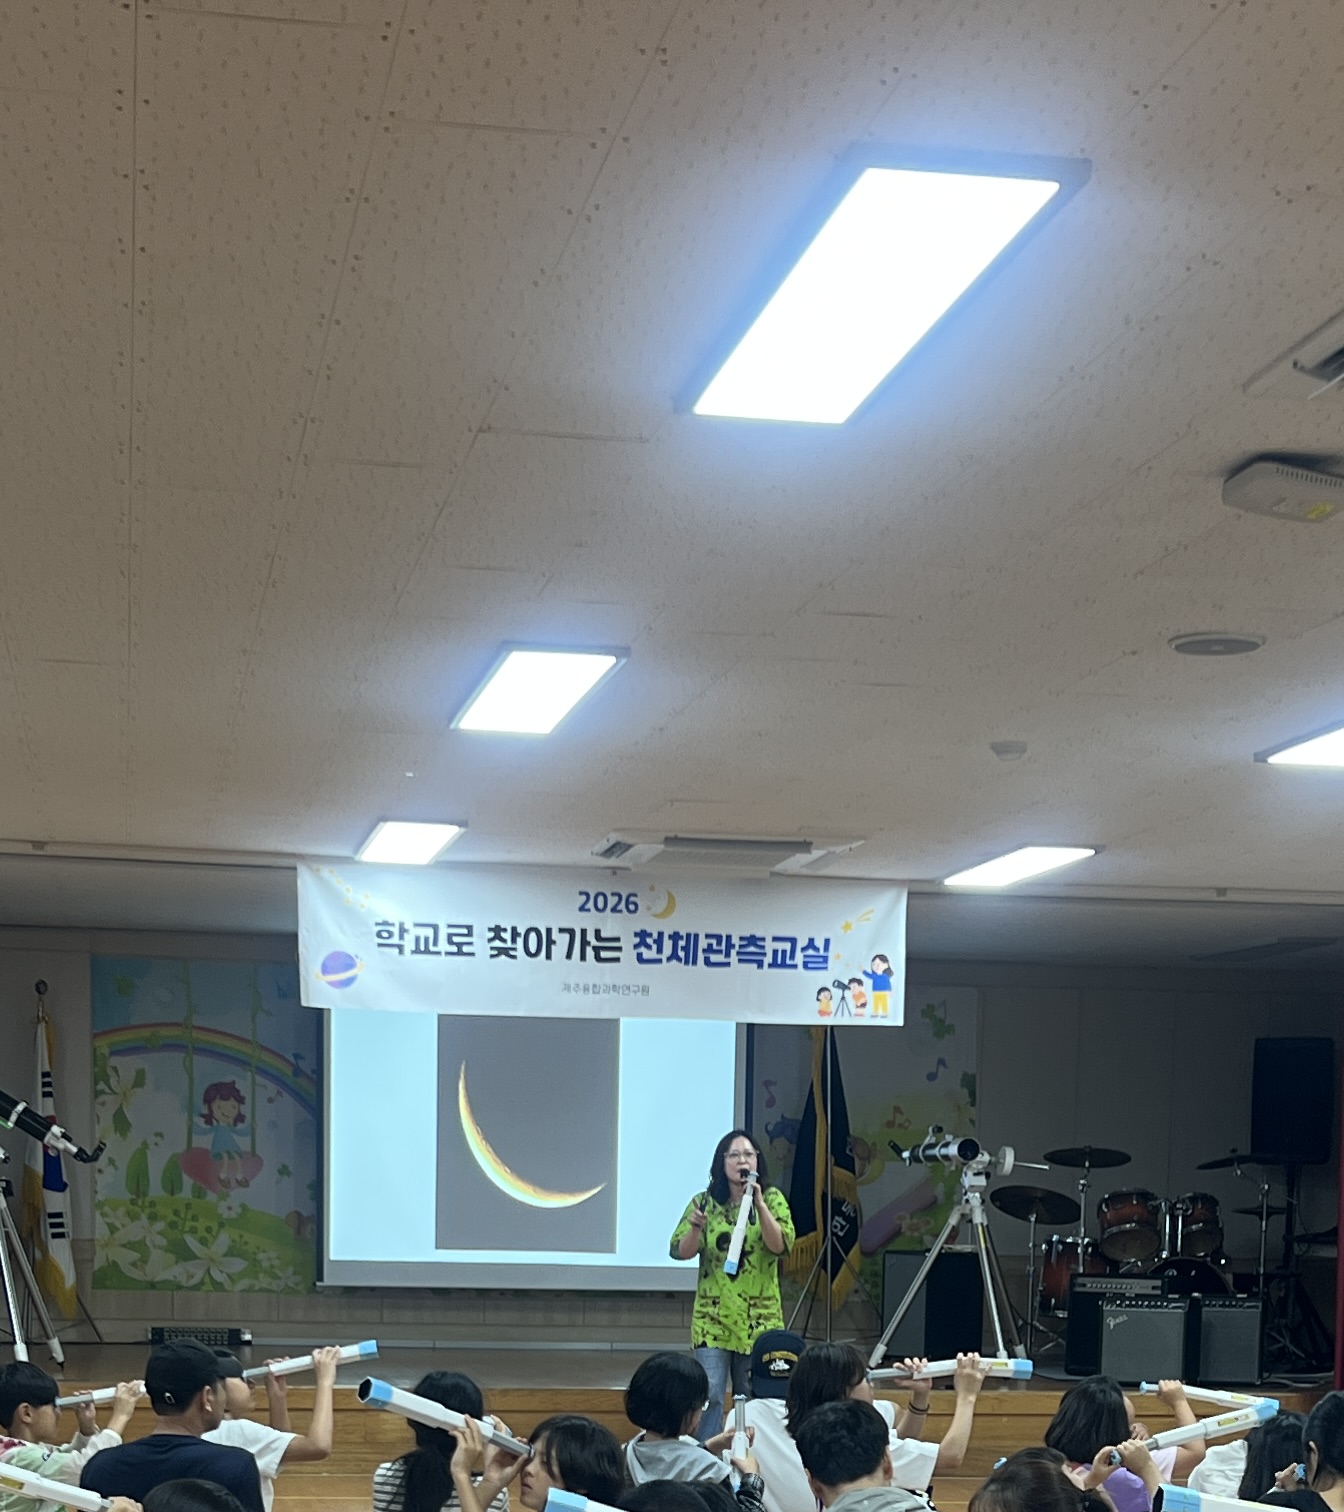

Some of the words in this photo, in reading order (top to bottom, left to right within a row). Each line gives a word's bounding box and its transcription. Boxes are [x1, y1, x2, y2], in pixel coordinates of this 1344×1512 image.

[577, 890, 640, 914] 2026
[374, 919, 476, 957] 학교로
[487, 924, 623, 963] 찾아가는
[632, 928, 831, 971] 천체관측교실
